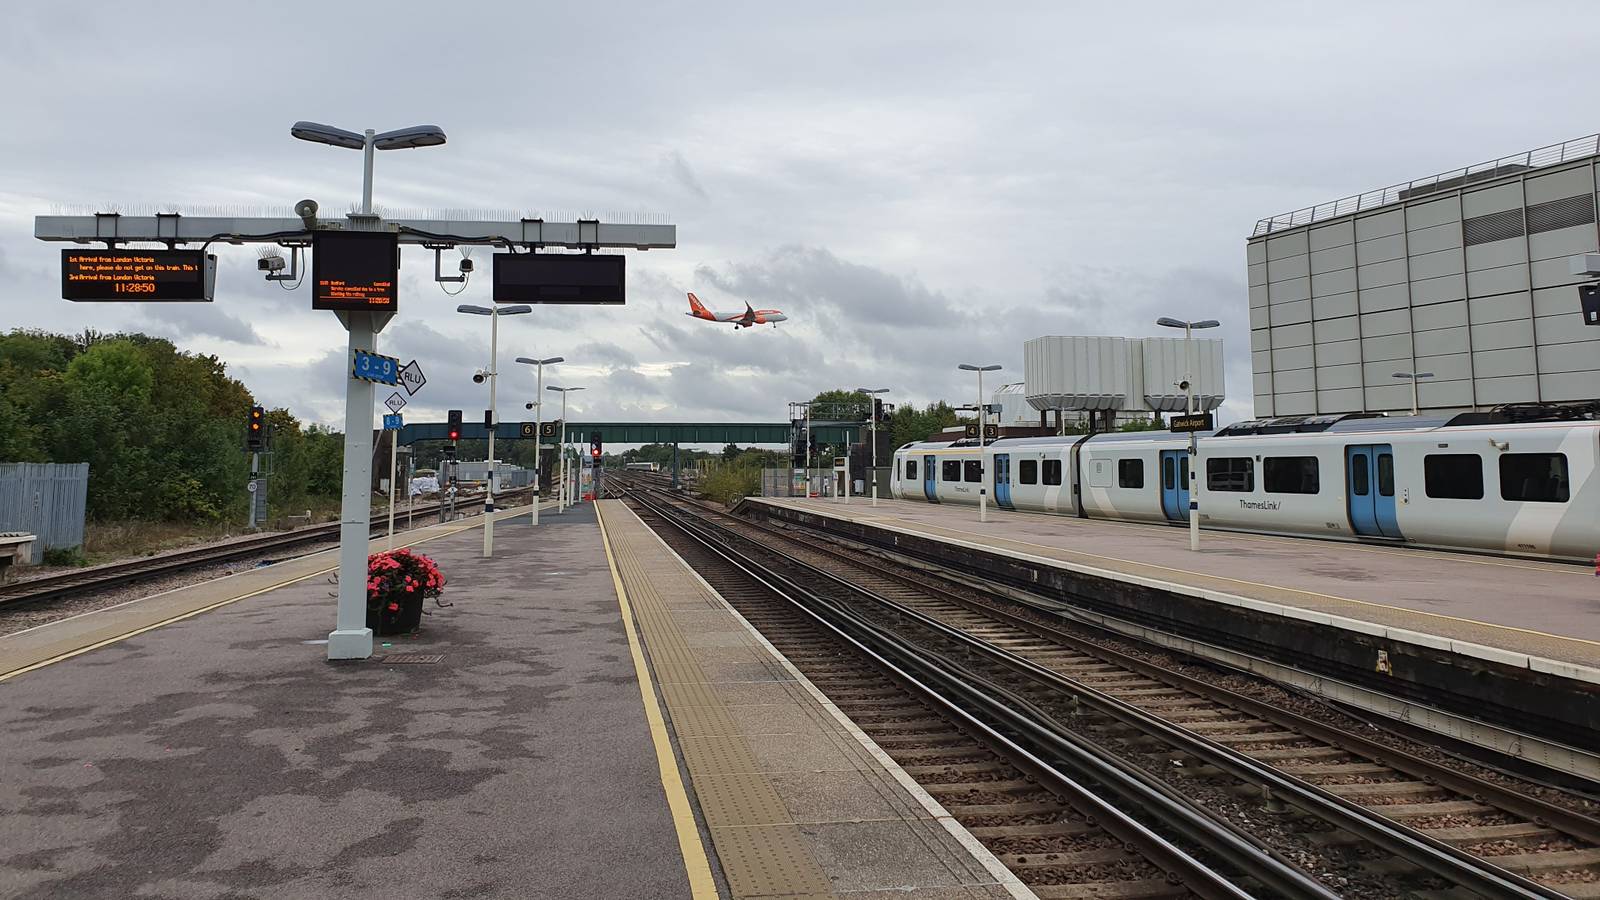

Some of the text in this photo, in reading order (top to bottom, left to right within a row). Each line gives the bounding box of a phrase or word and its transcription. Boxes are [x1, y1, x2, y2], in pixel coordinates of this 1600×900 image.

[96, 264, 114, 272] please
[115, 283, 155, 293] 11:28:50
[404, 372, 421, 384] RLU
[1190, 418, 1205, 428] Airport
[970, 427, 975, 435] 4
[988, 428, 994, 436] 3
